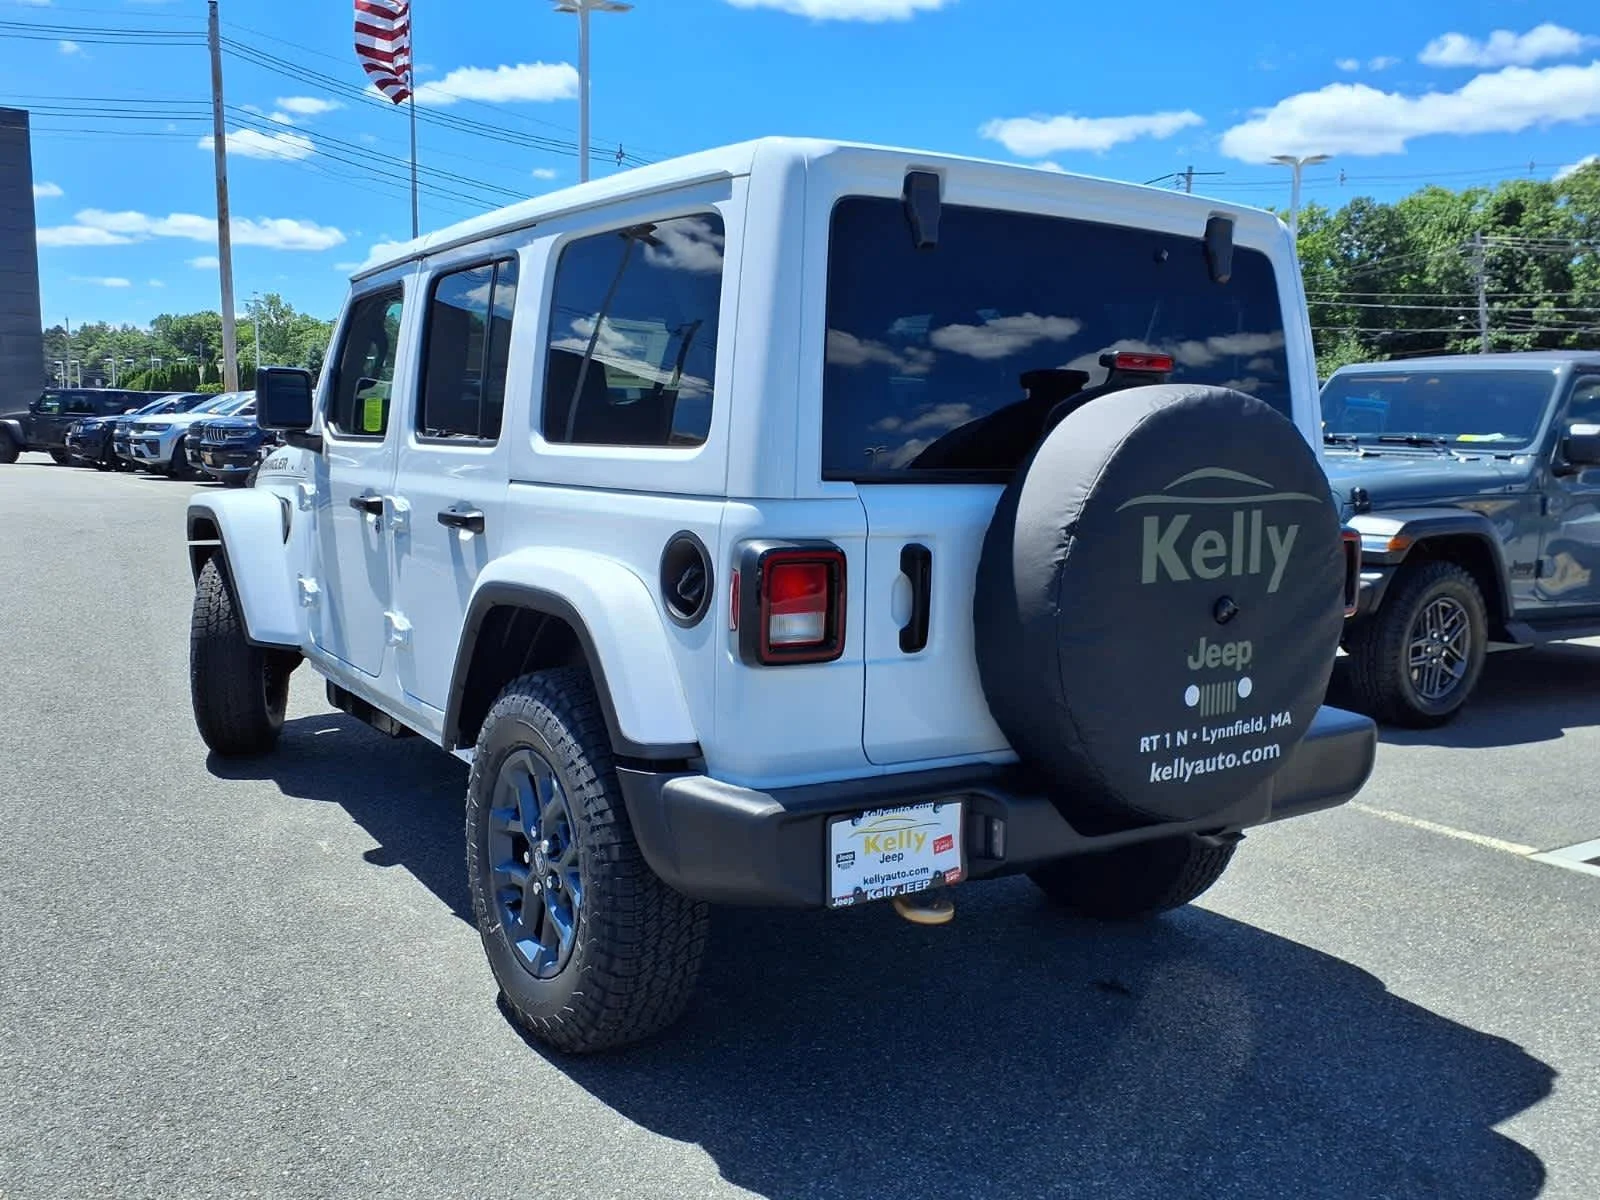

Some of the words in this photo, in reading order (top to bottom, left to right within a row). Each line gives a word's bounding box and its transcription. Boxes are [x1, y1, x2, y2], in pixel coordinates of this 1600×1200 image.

[1141, 509, 1300, 593] Kelly
[1187, 637, 1253, 671] Jeep
[1140, 735, 1160, 753] RT
[1165, 733, 1171, 749] 1
[1176, 730, 1188, 747] N
[1202, 716, 1267, 744] Lynnfield,
[1270, 711, 1292, 729] MA
[1150, 743, 1281, 783] kellyauto.com
[865, 830, 927, 855] Kelly
[879, 852, 904, 864] Jeep
[863, 866, 929, 886] kellyauto.com
[832, 896, 855, 907] Jeep
[867, 887, 897, 901] Kelly
[899, 880, 931, 895] JEEP
